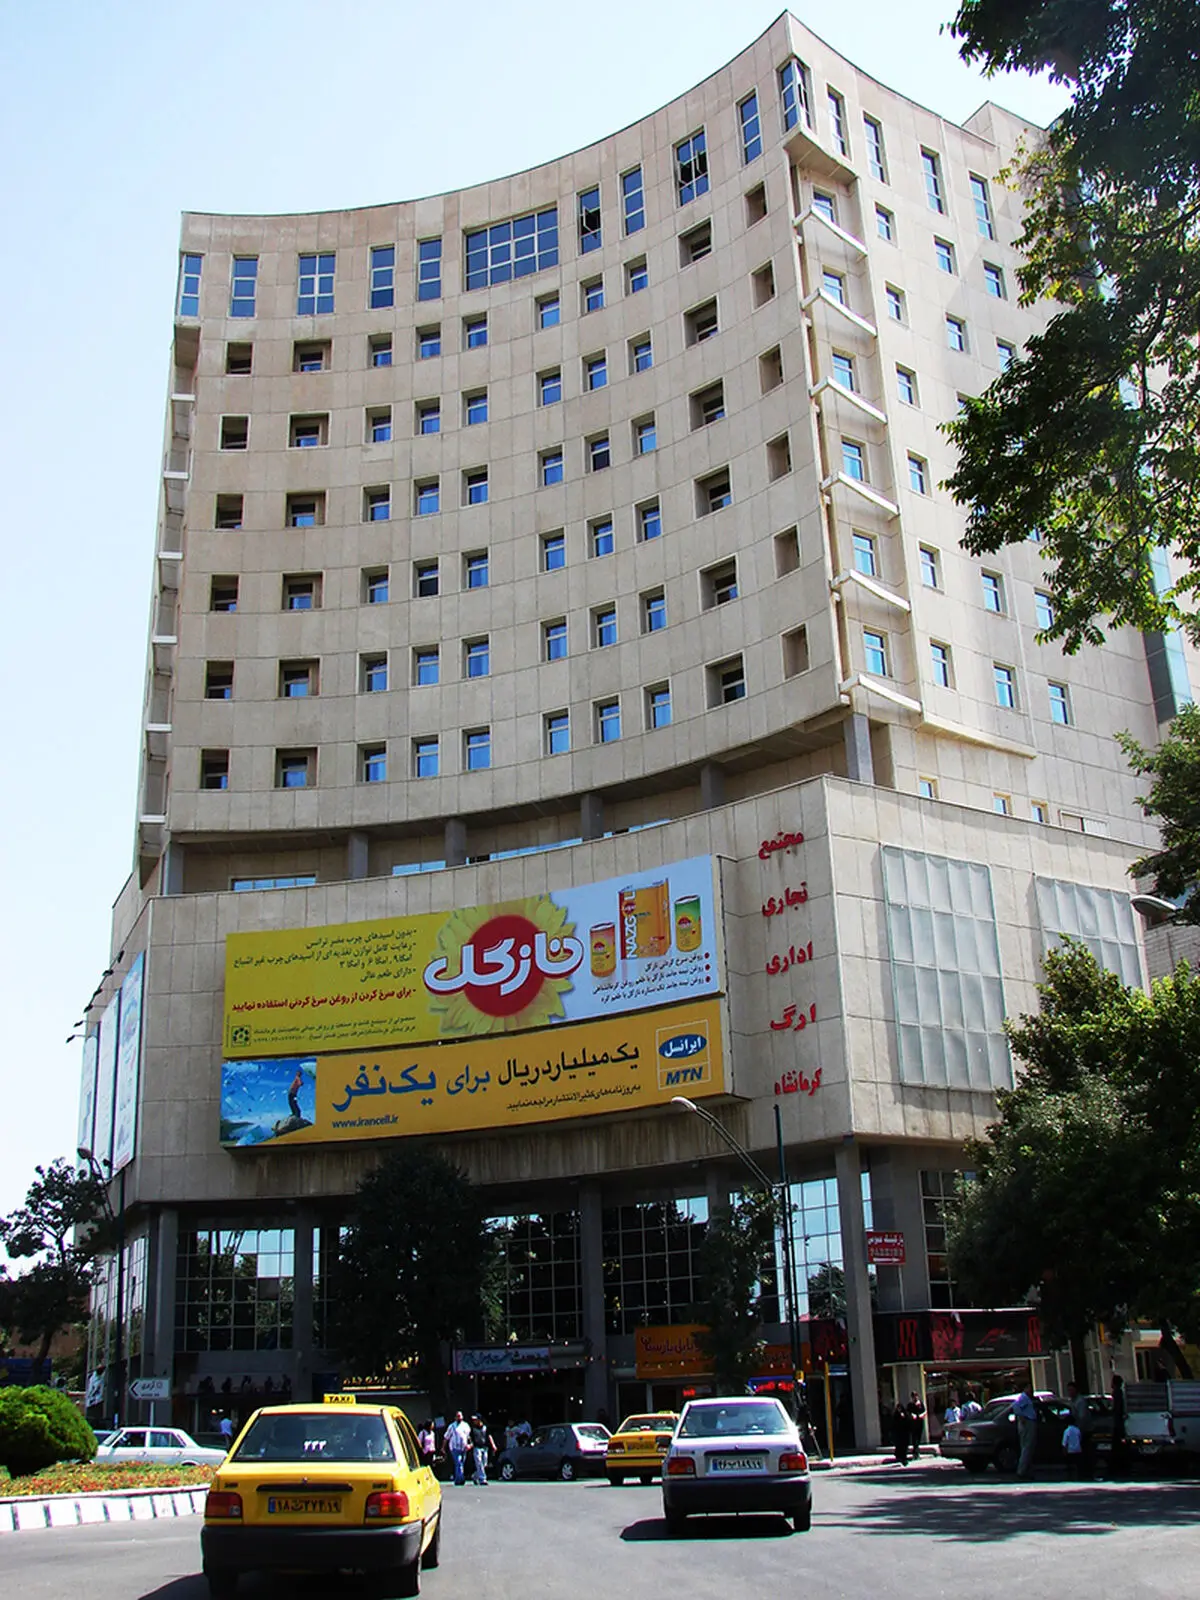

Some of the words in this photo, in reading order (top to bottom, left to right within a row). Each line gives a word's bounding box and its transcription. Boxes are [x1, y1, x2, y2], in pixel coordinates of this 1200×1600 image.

[759, 831, 804, 860] مجتمع
[762, 882, 808, 917] تجاری
[423, 931, 584, 996] نازگل
[766, 941, 813, 975] اداری
[256, 998, 288, 1009] استفاده
[289, 996, 311, 1009] کردنی
[311, 995, 328, 1008] سرخ
[329, 994, 349, 1006] روغن
[350, 991, 358, 1004] از
[359, 989, 378, 1002] کردن
[378, 990, 395, 1001] سرخ
[396, 986, 412, 1000] برای
[232, 1000, 256, 1012] نمایید
[770, 1003, 817, 1032] ارگ
[664, 1037, 702, 1058] ایرانسل
[446, 1064, 491, 1095] برای
[498, 1057, 541, 1087] ریال
[665, 1066, 703, 1087] MTN
[774, 1067, 823, 1096] کرمانشاه
[332, 1064, 388, 1112] نفر
[389, 1064, 437, 1106] یک
[331, 1114, 399, 1129] www.irancell.ir
[329, 1395, 351, 1404] TAXI
